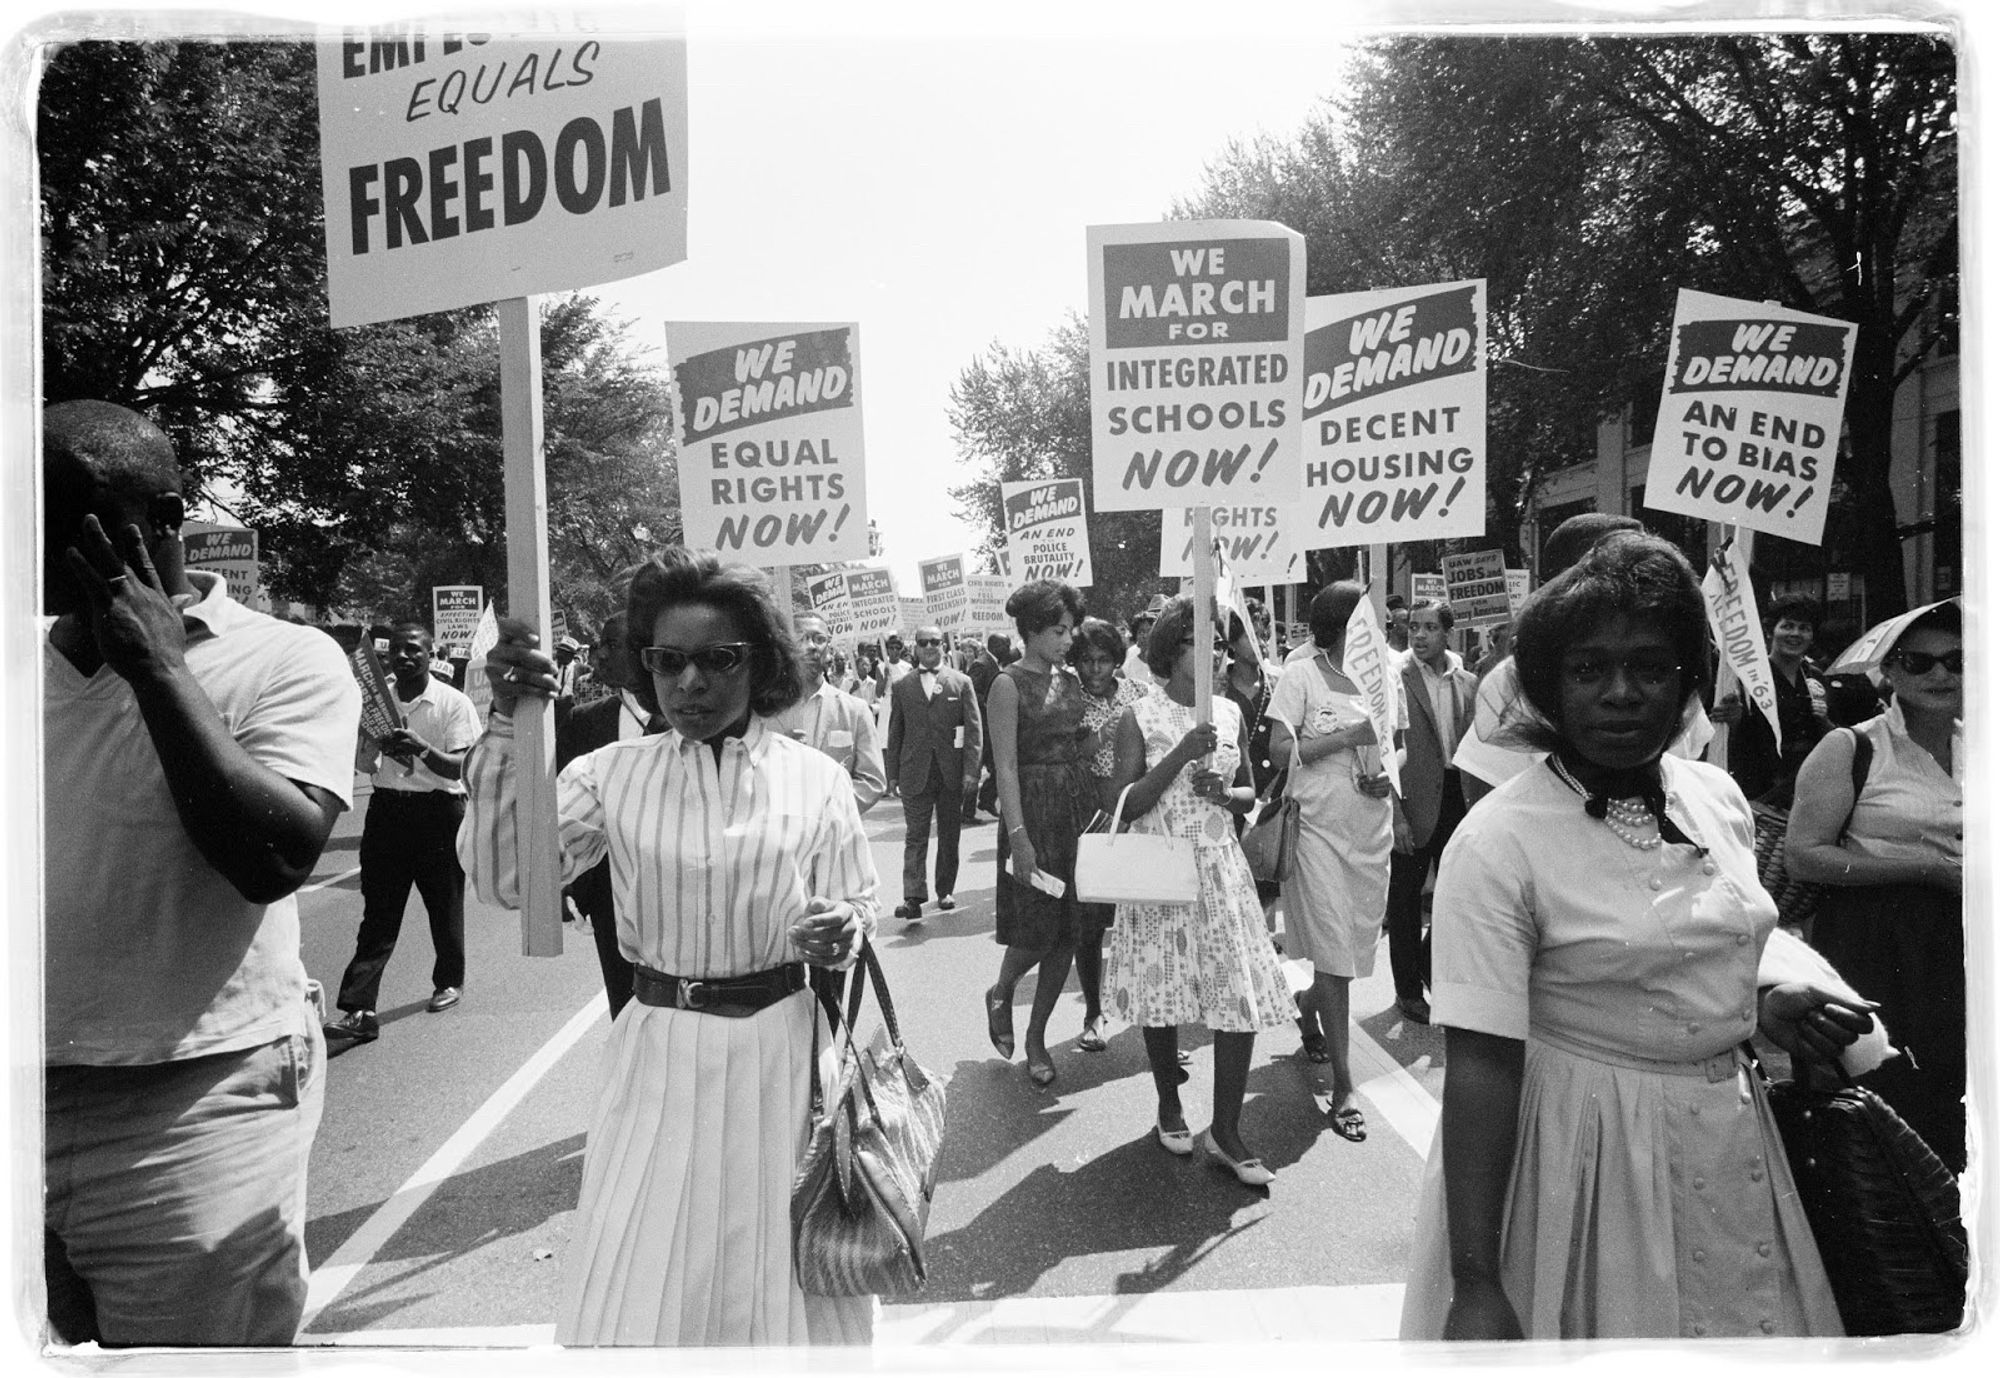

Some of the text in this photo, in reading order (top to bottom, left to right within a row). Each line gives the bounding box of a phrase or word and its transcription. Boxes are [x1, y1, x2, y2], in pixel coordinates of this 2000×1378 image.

[406, 40, 600, 122] EQUALS
[349, 97, 671, 256] FREEDOM
[1170, 248, 1225, 277] WE
[1119, 279, 1275, 319] MARCH
[1168, 322, 1230, 340] FOR
[1349, 304, 1417, 355] WE
[1731, 323, 1797, 352] WE
[734, 340, 797, 383] WE
[1106, 353, 1289, 391] INTEGRATED
[1303, 327, 1471, 410] DEMAND
[1682, 354, 1838, 387] DEMAND
[693, 366, 848, 432] DEMAND
[1108, 399, 1286, 436] SCHOOLS
[1320, 406, 1461, 446] DECENT
[1682, 400, 1826, 449] AN END
[711, 438, 839, 469] EQUAL
[1122, 437, 1279, 490] NOW!
[1306, 447, 1474, 488] HOUSING
[1682, 431, 1819, 482] TO BIAS
[711, 473, 845, 505] RIGHTS
[1030, 485, 1057, 506] WE
[1318, 475, 1466, 529] NOW!
[1675, 465, 1814, 519] NOW!
[715, 503, 850, 550] NOW!
[1013, 496, 1078, 529] DEMAND
[1184, 507, 1278, 527] RGHTS
[206, 532, 233, 546] WE
[1020, 527, 1076, 540] AN END
[1033, 542, 1068, 553] POLICE
[188, 544, 252, 561] DEMAND
[1024, 552, 1075, 565] BRUTALITY
[824, 576, 841, 590] WE
[861, 573, 875, 581] WE
[927, 569, 960, 585] MARCH
[1025, 558, 1084, 581] NOW!
[1449, 566, 1485, 584] JOBS
[852, 578, 889, 592] MARCH
[1417, 584, 1445, 592] MARC
[1450, 581, 1506, 601] FREEDOM
[854, 605, 897, 619] SCHOOLS
[860, 614, 896, 630] NOW!
[972, 611, 1003, 621] REEDOM
[355, 648, 376, 688] MARCH
[1747, 669, 1759, 682] IN
